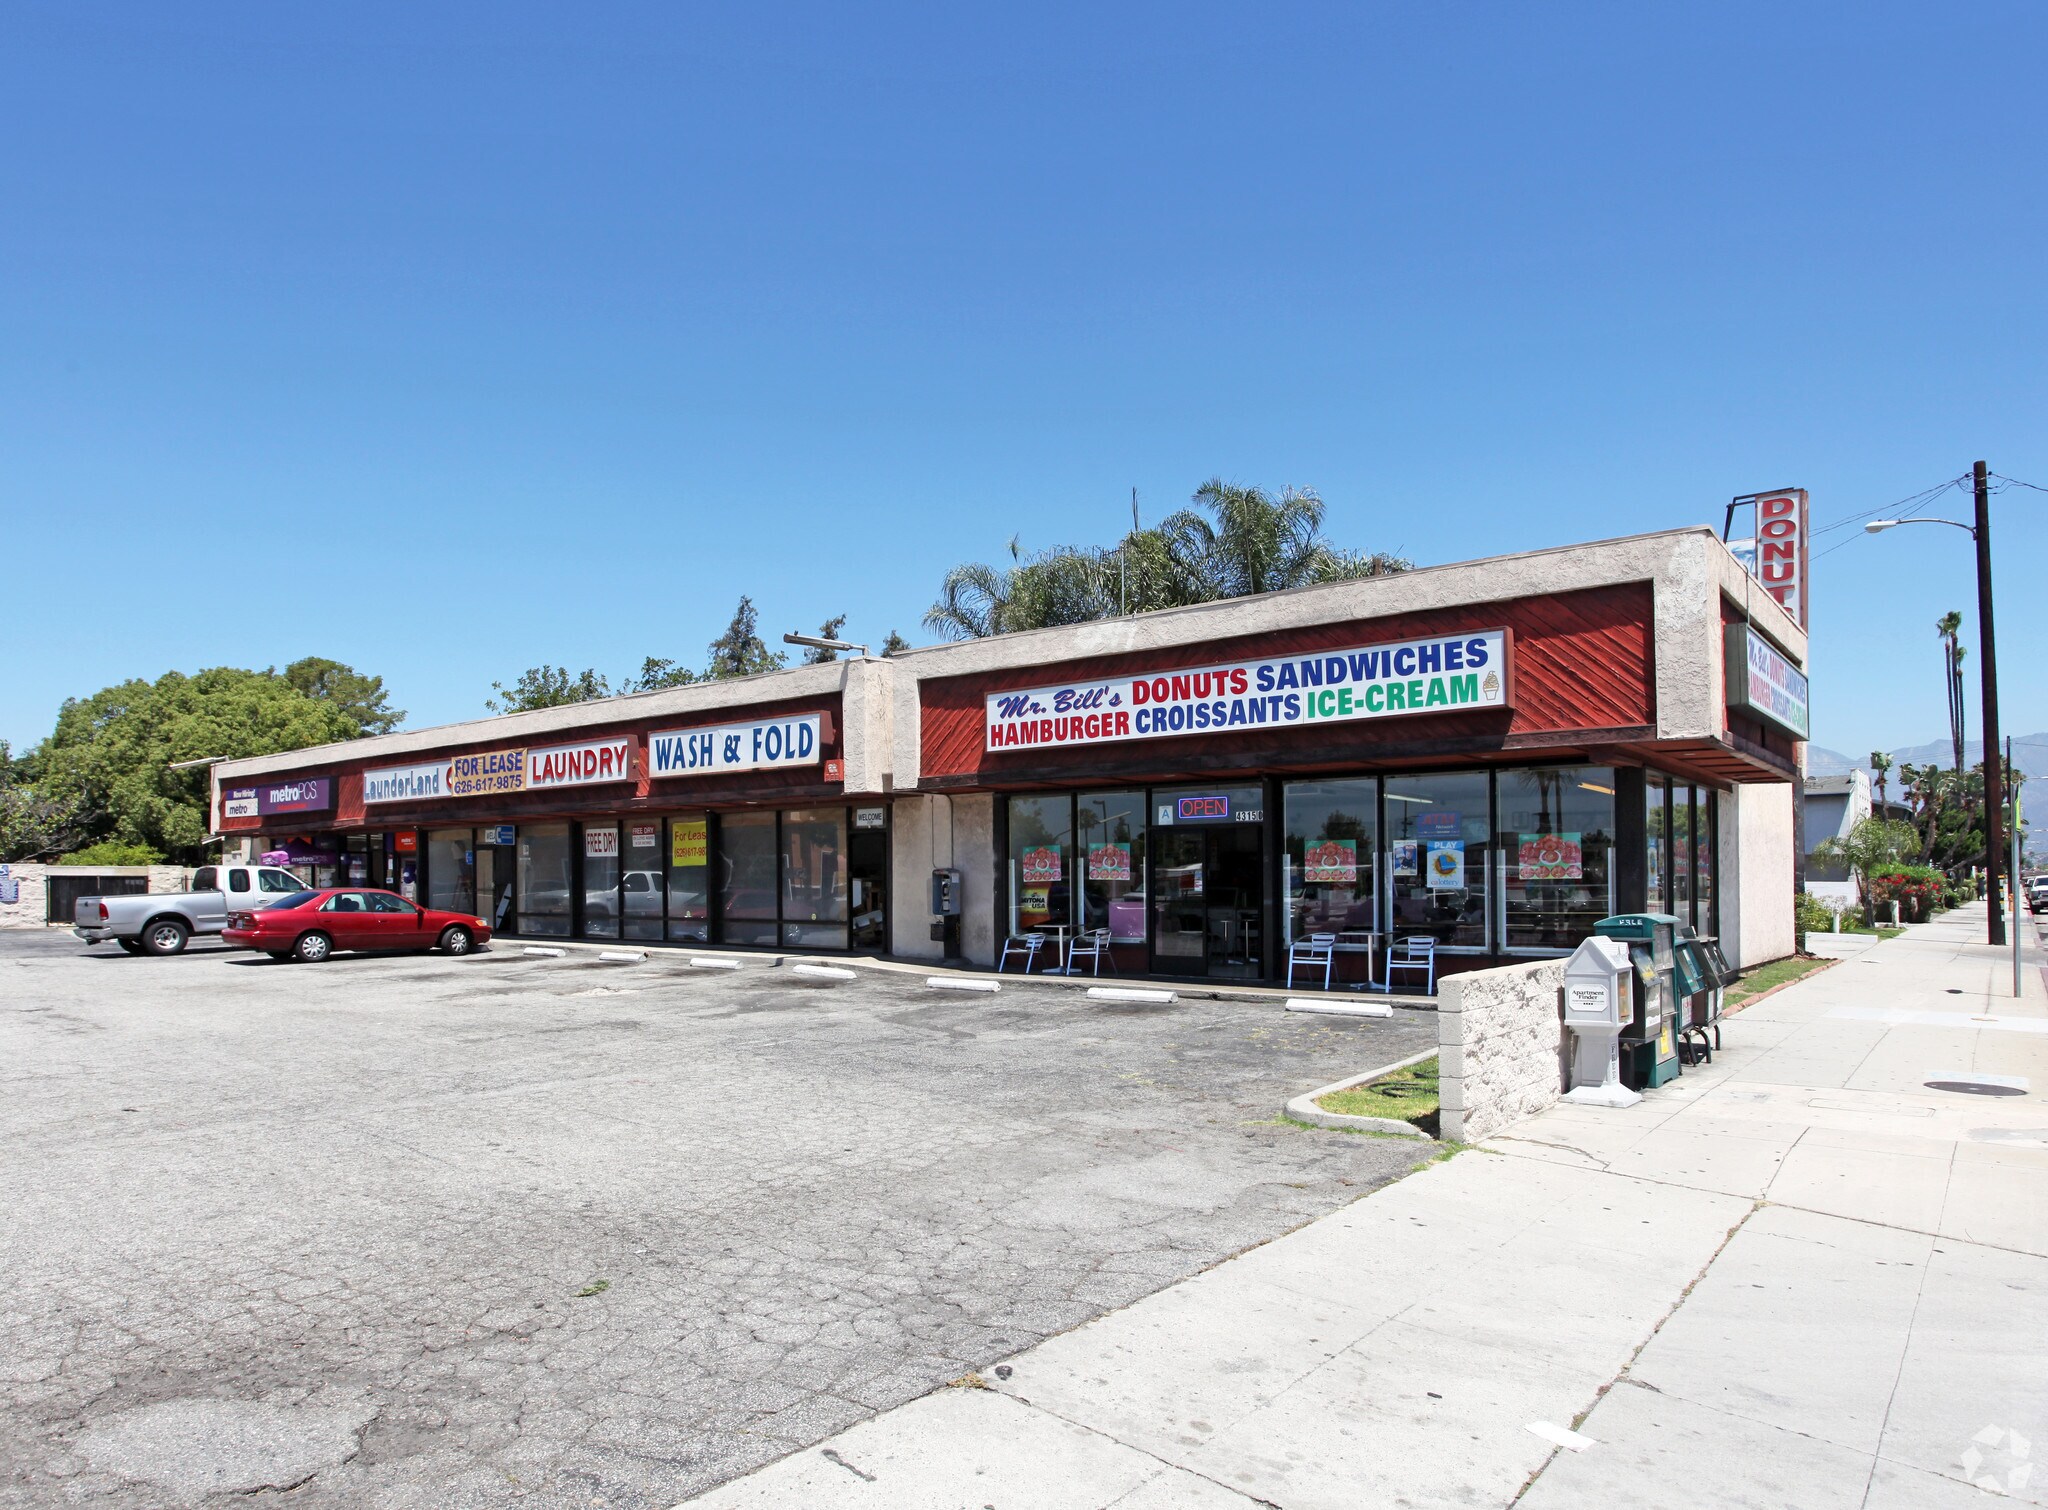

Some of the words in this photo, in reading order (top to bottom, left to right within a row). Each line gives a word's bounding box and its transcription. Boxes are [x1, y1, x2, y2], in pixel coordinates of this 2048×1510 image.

[997, 696, 1047, 719] Mr.
[1053, 685, 1122, 713] Bill's
[1132, 668, 1248, 705] DONUTS
[1256, 638, 1489, 692] SANDWICHES
[990, 711, 1130, 747] HAMBURGER
[1135, 693, 1300, 734] CROISSANTS
[1307, 673, 1479, 719] ICE-CREAM
[655, 733, 713, 771] WASH
[723, 734, 741, 764] &
[752, 722, 814, 763] FOLD
[454, 756, 479, 777] FOR
[483, 752, 523, 775] LEASE
[532, 745, 627, 783] LAUNDRY
[269, 780, 317, 803] metroPCS
[364, 767, 440, 801] LaunderLand
[454, 774, 522, 794] 626-617-9875
[857, 813, 882, 821] WELCOME
[1161, 809, 1170, 819] A
[1181, 799, 1226, 817] OPEN
[1422, 813, 1456, 825] ATM
[586, 832, 602, 853] FREE
[603, 832, 618, 853] DRY
[674, 831, 687, 842] For
[688, 830, 707, 841] Leas
[1571, 989, 1604, 997] Apartment
